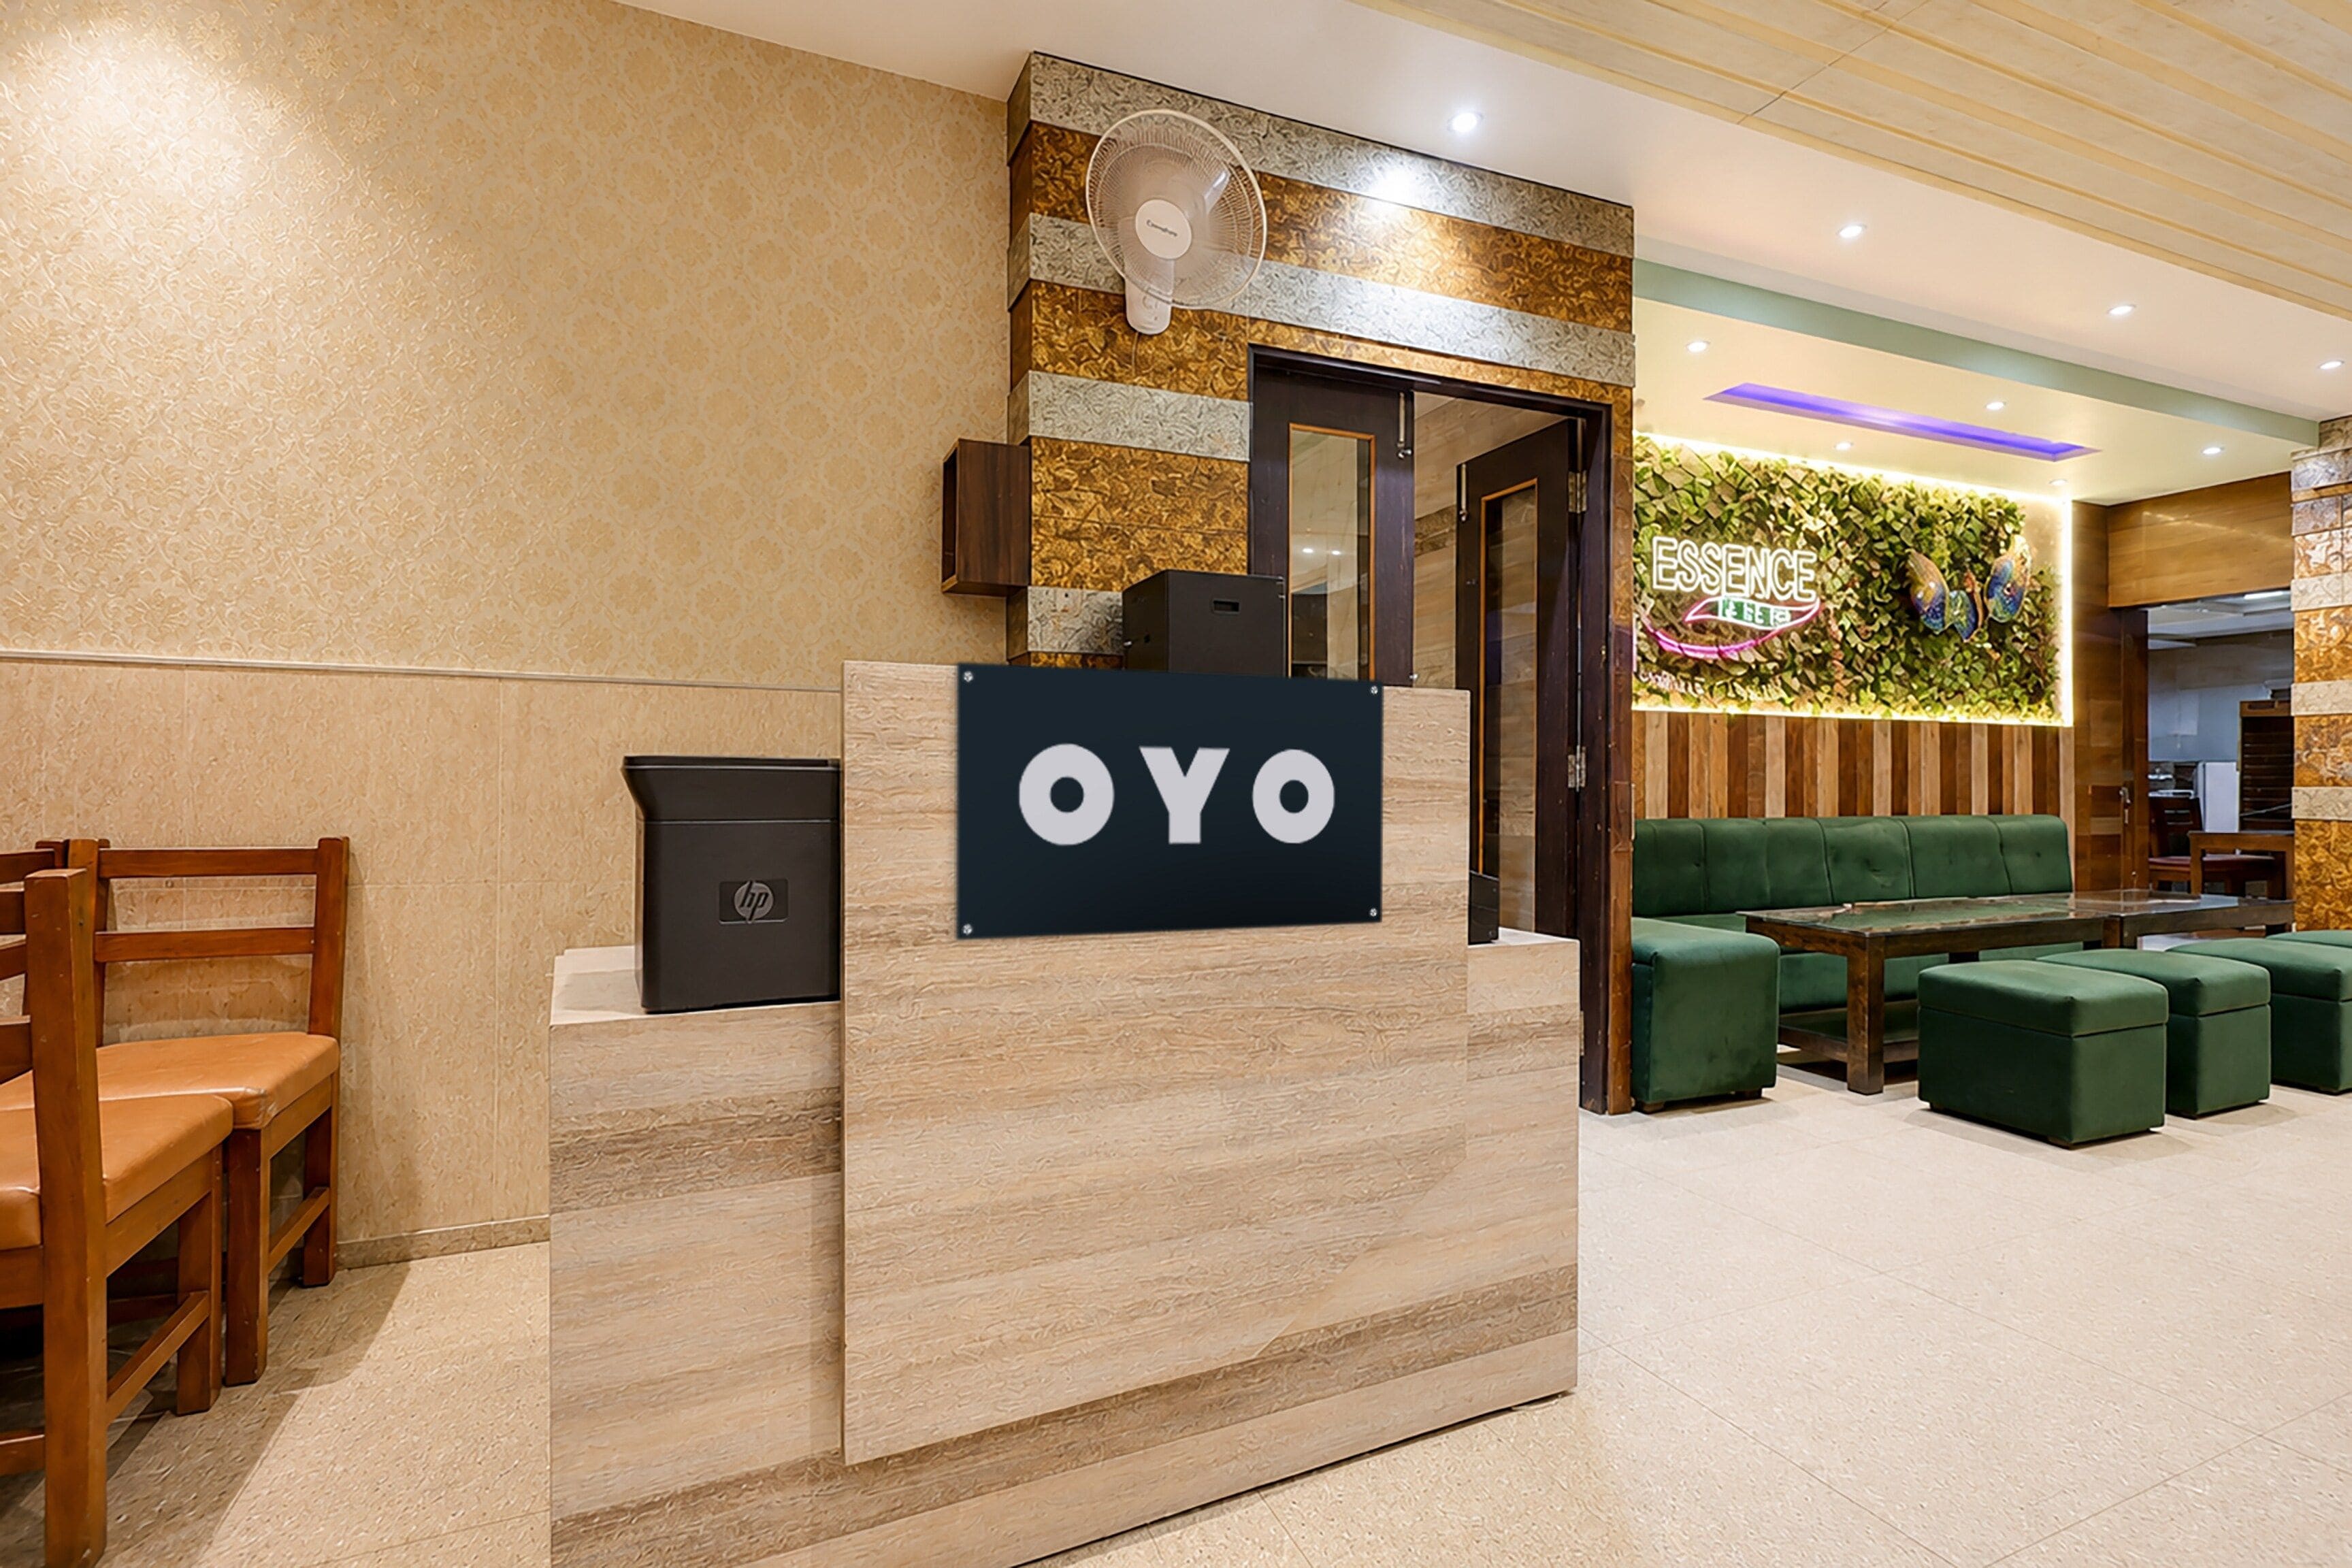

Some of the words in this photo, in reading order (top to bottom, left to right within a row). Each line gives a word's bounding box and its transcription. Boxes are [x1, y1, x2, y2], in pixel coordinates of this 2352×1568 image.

[1652, 536, 1818, 602] ESSENCE
[1018, 742, 1336, 846] OYO
[738, 880, 770, 921] hp
